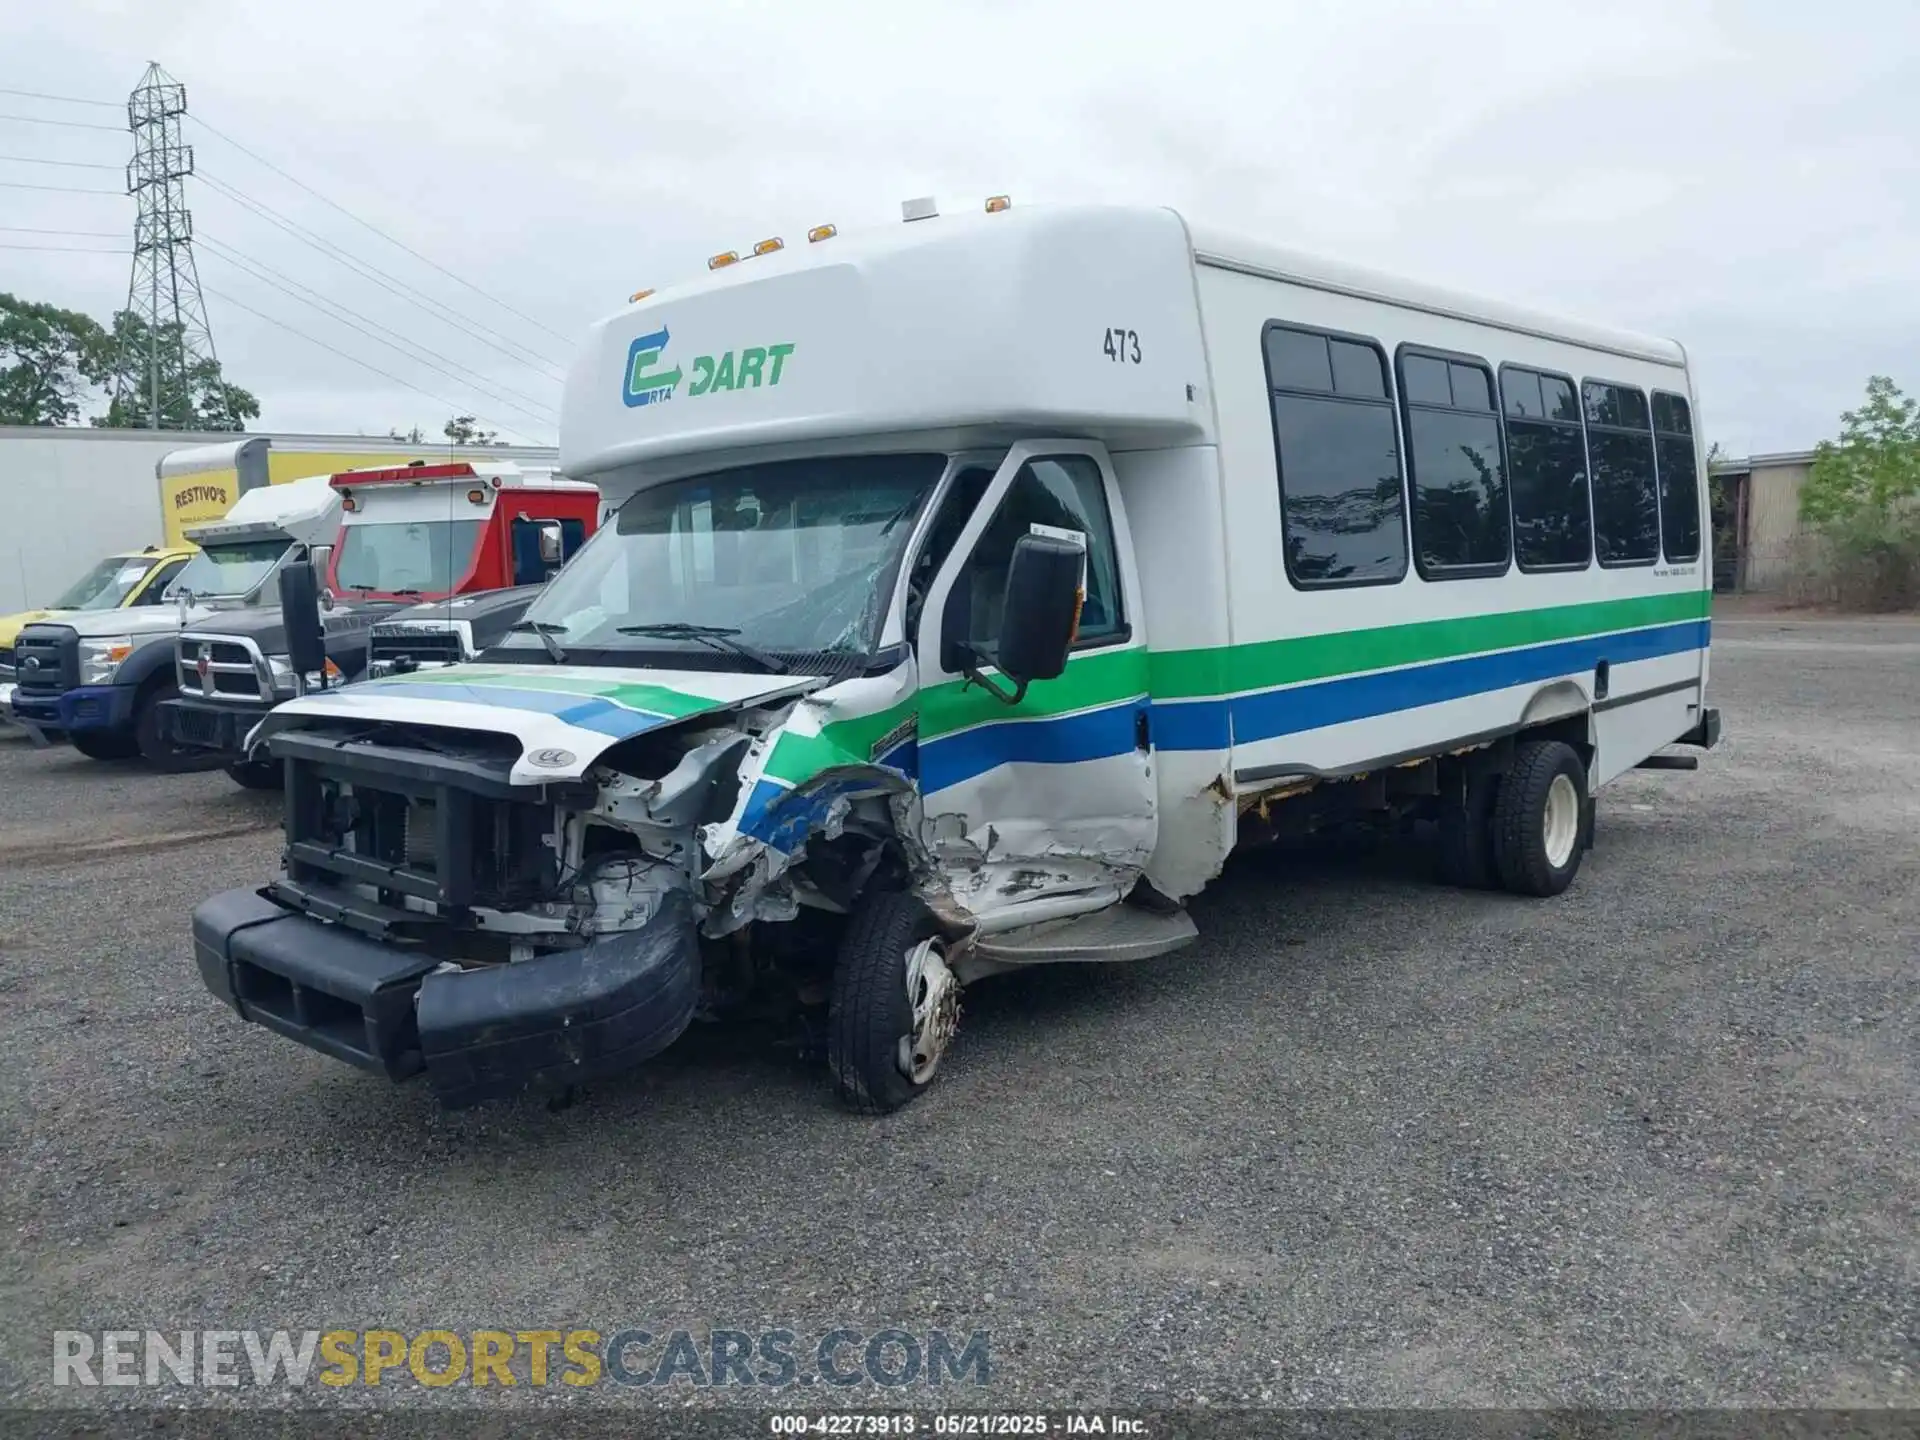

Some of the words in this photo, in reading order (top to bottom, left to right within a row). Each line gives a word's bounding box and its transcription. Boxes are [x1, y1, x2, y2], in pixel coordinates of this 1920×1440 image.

[1104, 327, 1141, 364] 473
[688, 343, 796, 397] DART
[650, 387, 671, 404] RTA
[175, 486, 226, 509] RESTIVO'S
